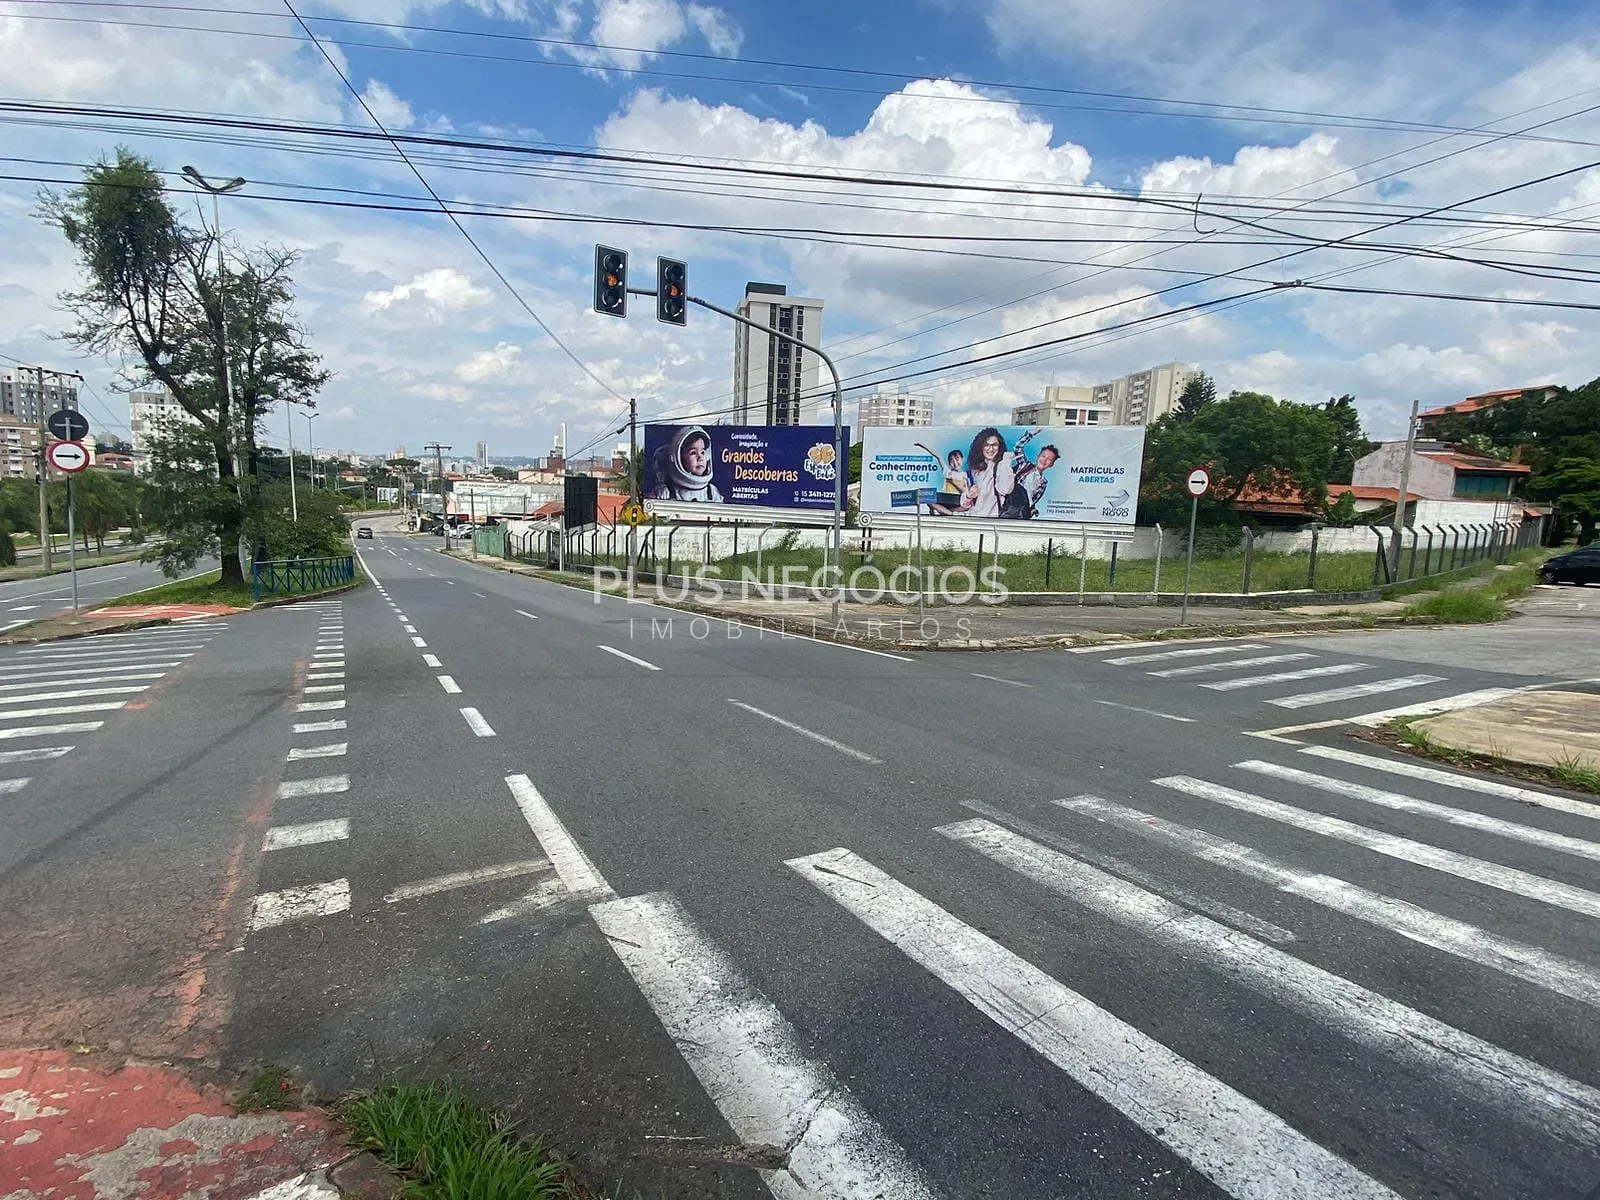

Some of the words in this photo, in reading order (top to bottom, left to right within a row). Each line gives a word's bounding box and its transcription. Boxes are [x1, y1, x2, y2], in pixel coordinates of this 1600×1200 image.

[721, 448, 765, 464] Grandes
[869, 462, 938, 472] Conhecimento
[1070, 465, 1125, 475] MATRÍCULAS
[735, 465, 799, 482] Descobertas
[876, 473, 894, 482] em
[896, 472, 929, 484] ação!
[1078, 475, 1115, 484] ABERTAS
[732, 486, 769, 495] MATRÍCULAS
[1102, 510, 1129, 518] NOVO
